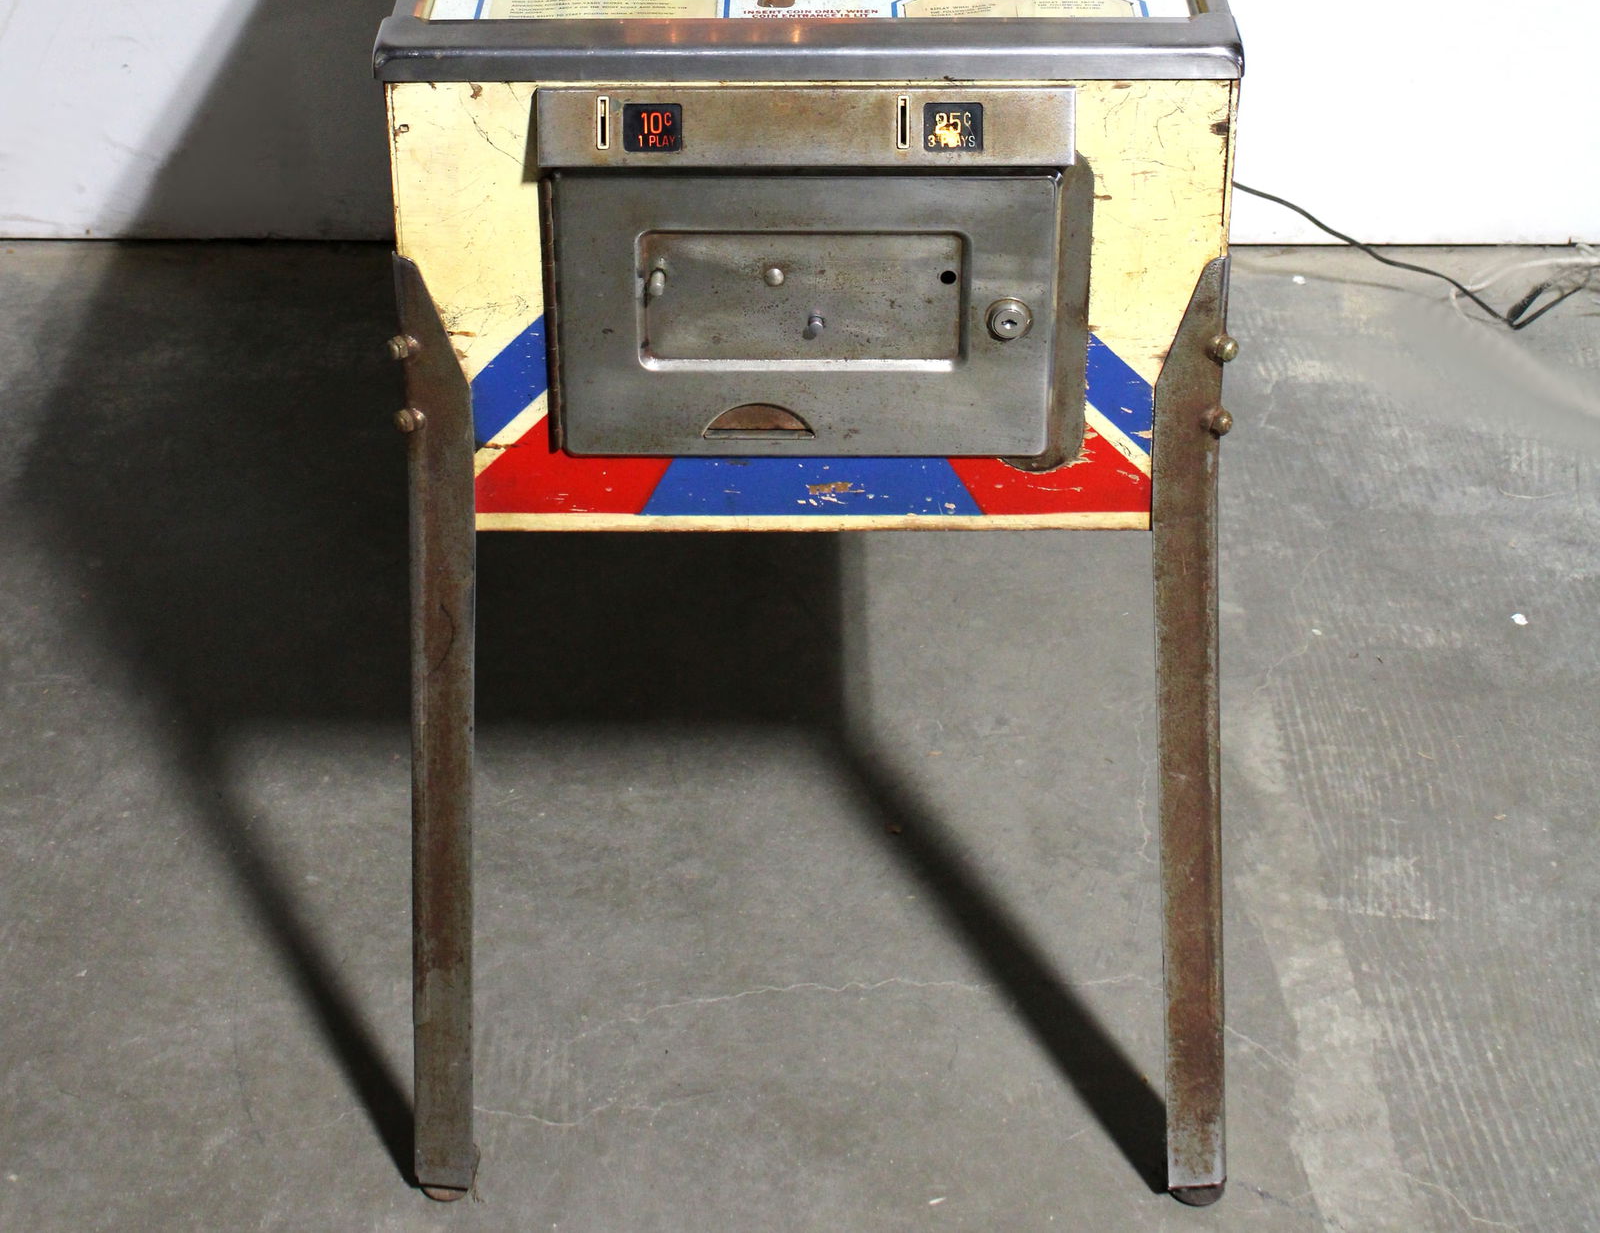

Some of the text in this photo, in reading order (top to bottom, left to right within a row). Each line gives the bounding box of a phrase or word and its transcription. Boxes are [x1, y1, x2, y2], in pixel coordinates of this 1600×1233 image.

[638, 135, 676, 147] 1 PLAY
[927, 135, 937, 147] 3
